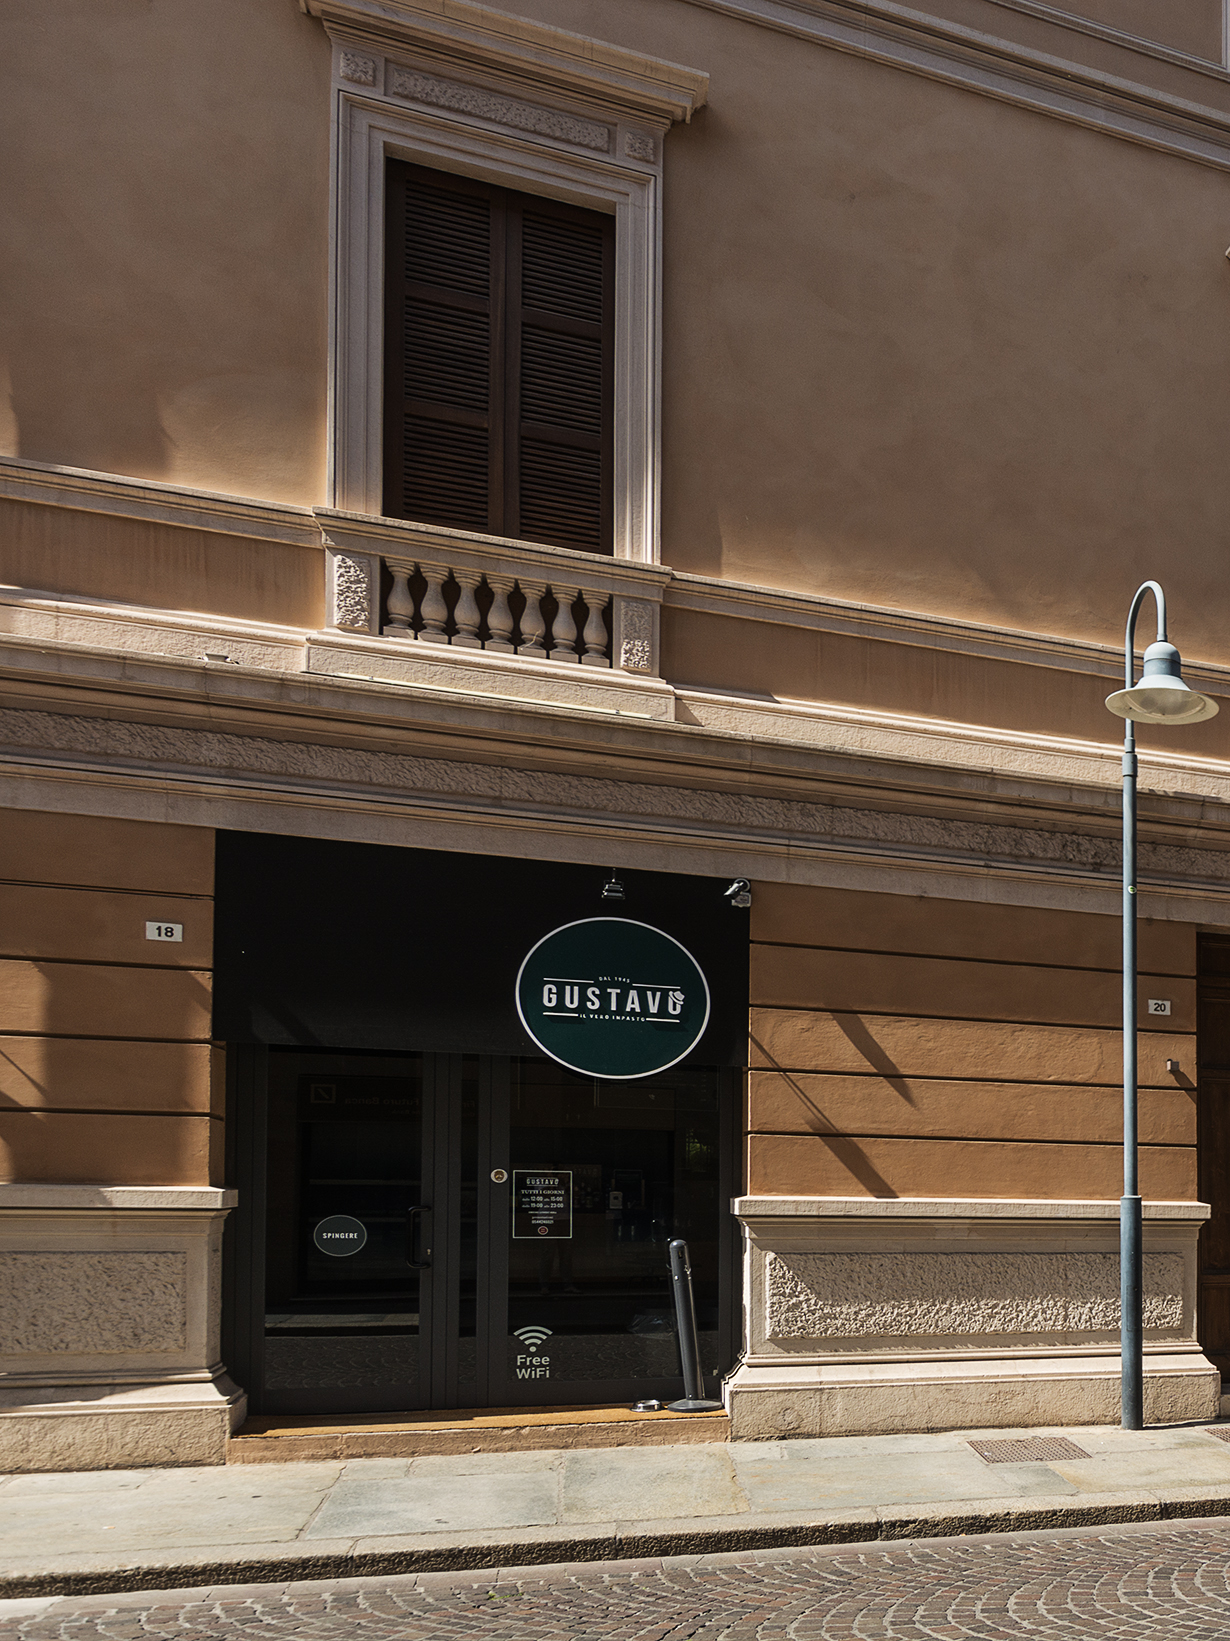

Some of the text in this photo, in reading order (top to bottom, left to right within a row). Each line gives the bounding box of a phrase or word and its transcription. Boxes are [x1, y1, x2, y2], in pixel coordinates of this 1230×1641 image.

[156, 926, 174, 938] 18
[542, 983, 685, 1015] GUSTAVO
[1154, 1003, 1166, 1012] 20
[516, 1354, 550, 1366] Free
[515, 1366, 550, 1380] WiFi
